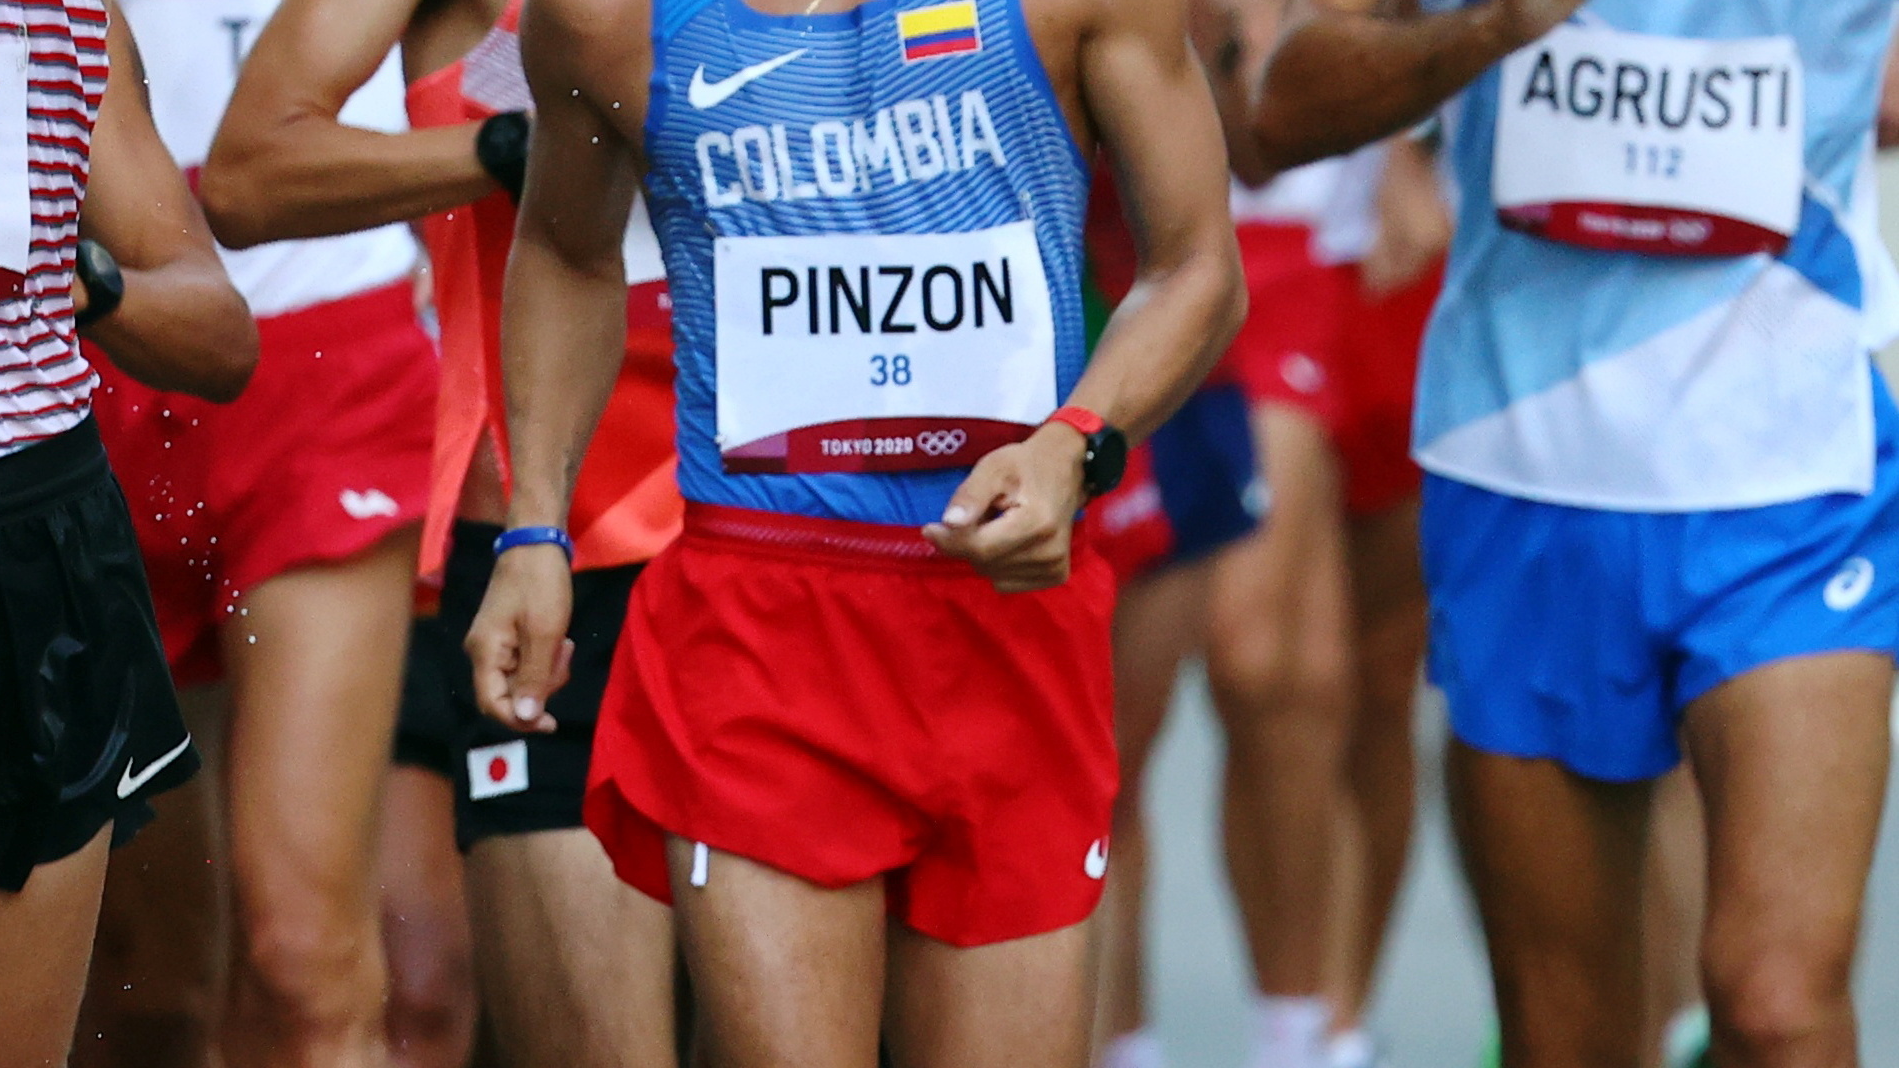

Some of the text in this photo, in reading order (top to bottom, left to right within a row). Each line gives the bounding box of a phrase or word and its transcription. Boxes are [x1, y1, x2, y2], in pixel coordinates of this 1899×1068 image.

[1521, 49, 1789, 130] AGRUSTI
[695, 88, 1007, 209] COLOMBIA
[761, 257, 1013, 335] PINZON
[869, 353, 912, 386] 38
[820, 436, 914, 456] TOKYO 2020
